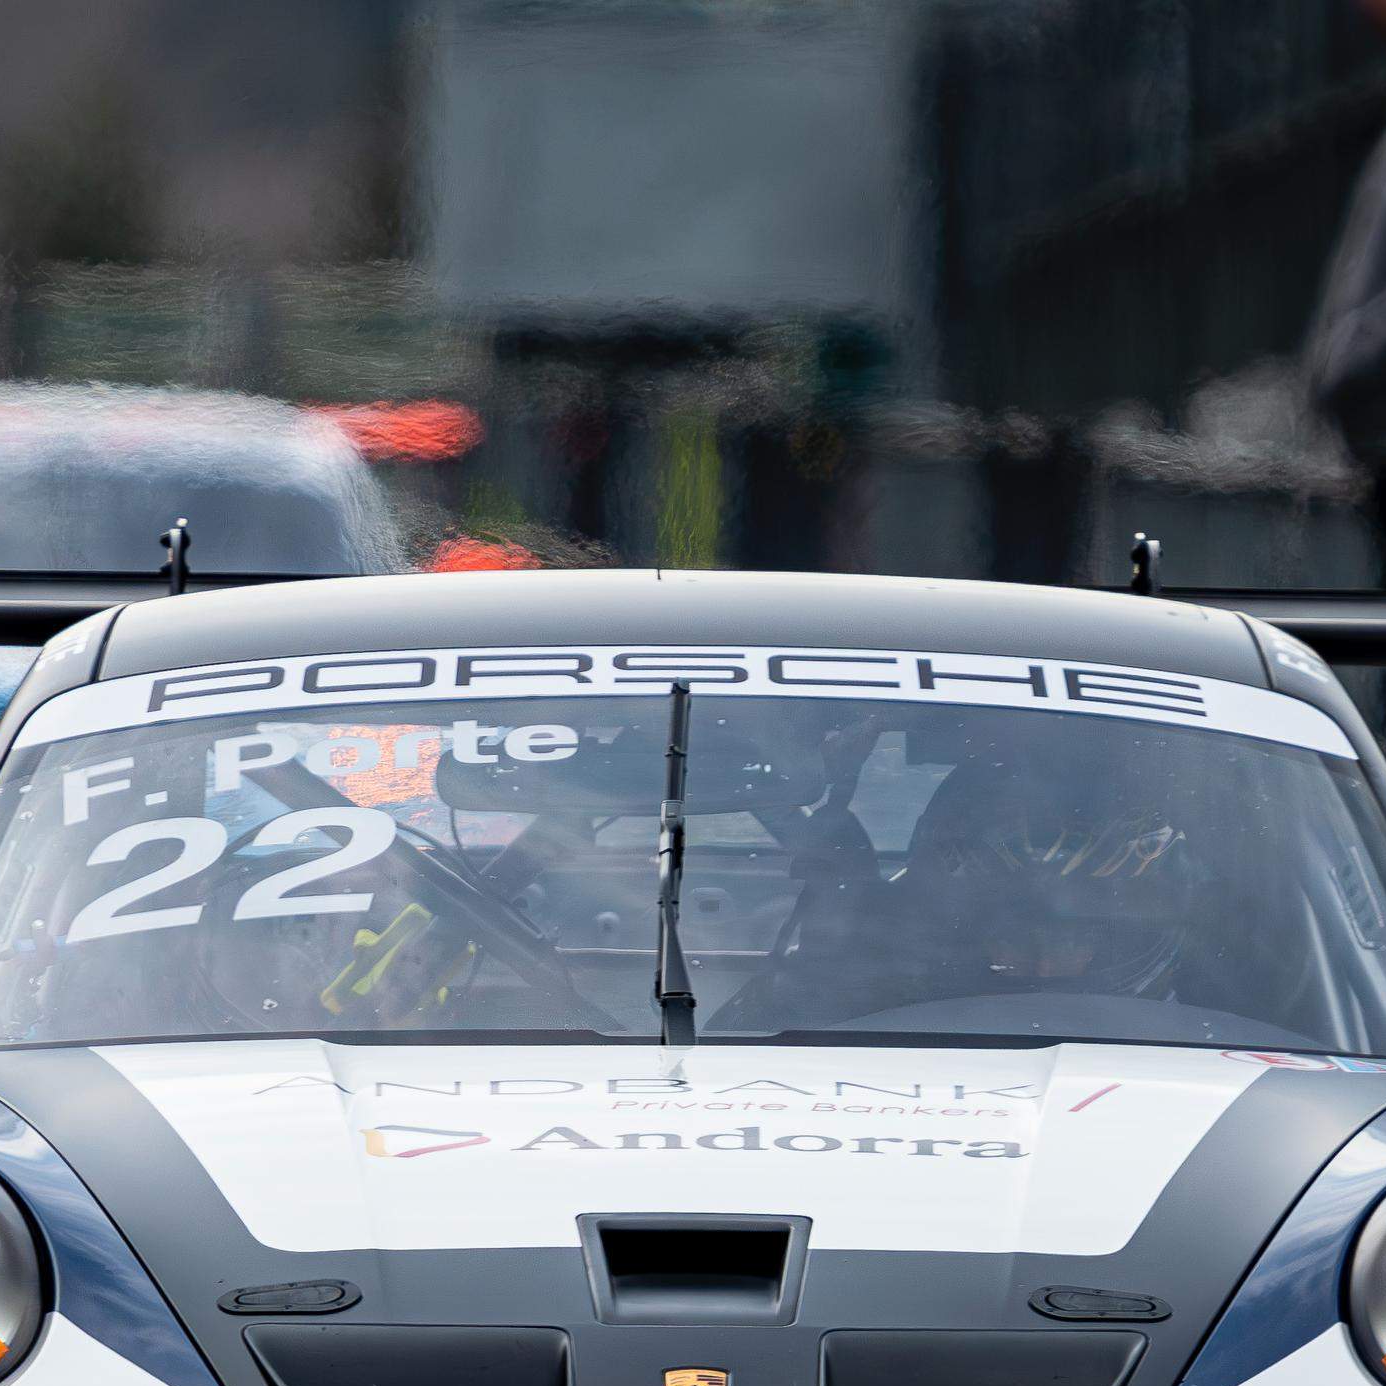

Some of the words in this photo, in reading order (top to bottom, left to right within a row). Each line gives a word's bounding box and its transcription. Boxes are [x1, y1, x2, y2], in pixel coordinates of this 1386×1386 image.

[147, 652, 1208, 718] PORSCHE
[62, 756, 169, 827] F.
[212, 719, 581, 793] Porte
[65, 806, 397, 944] 22
[252, 1075, 1043, 1100] ANDBANK
[610, 1100, 789, 1113] Private
[811, 1102, 1015, 1118] Bankers
[510, 1126, 1032, 1159] Andorra
